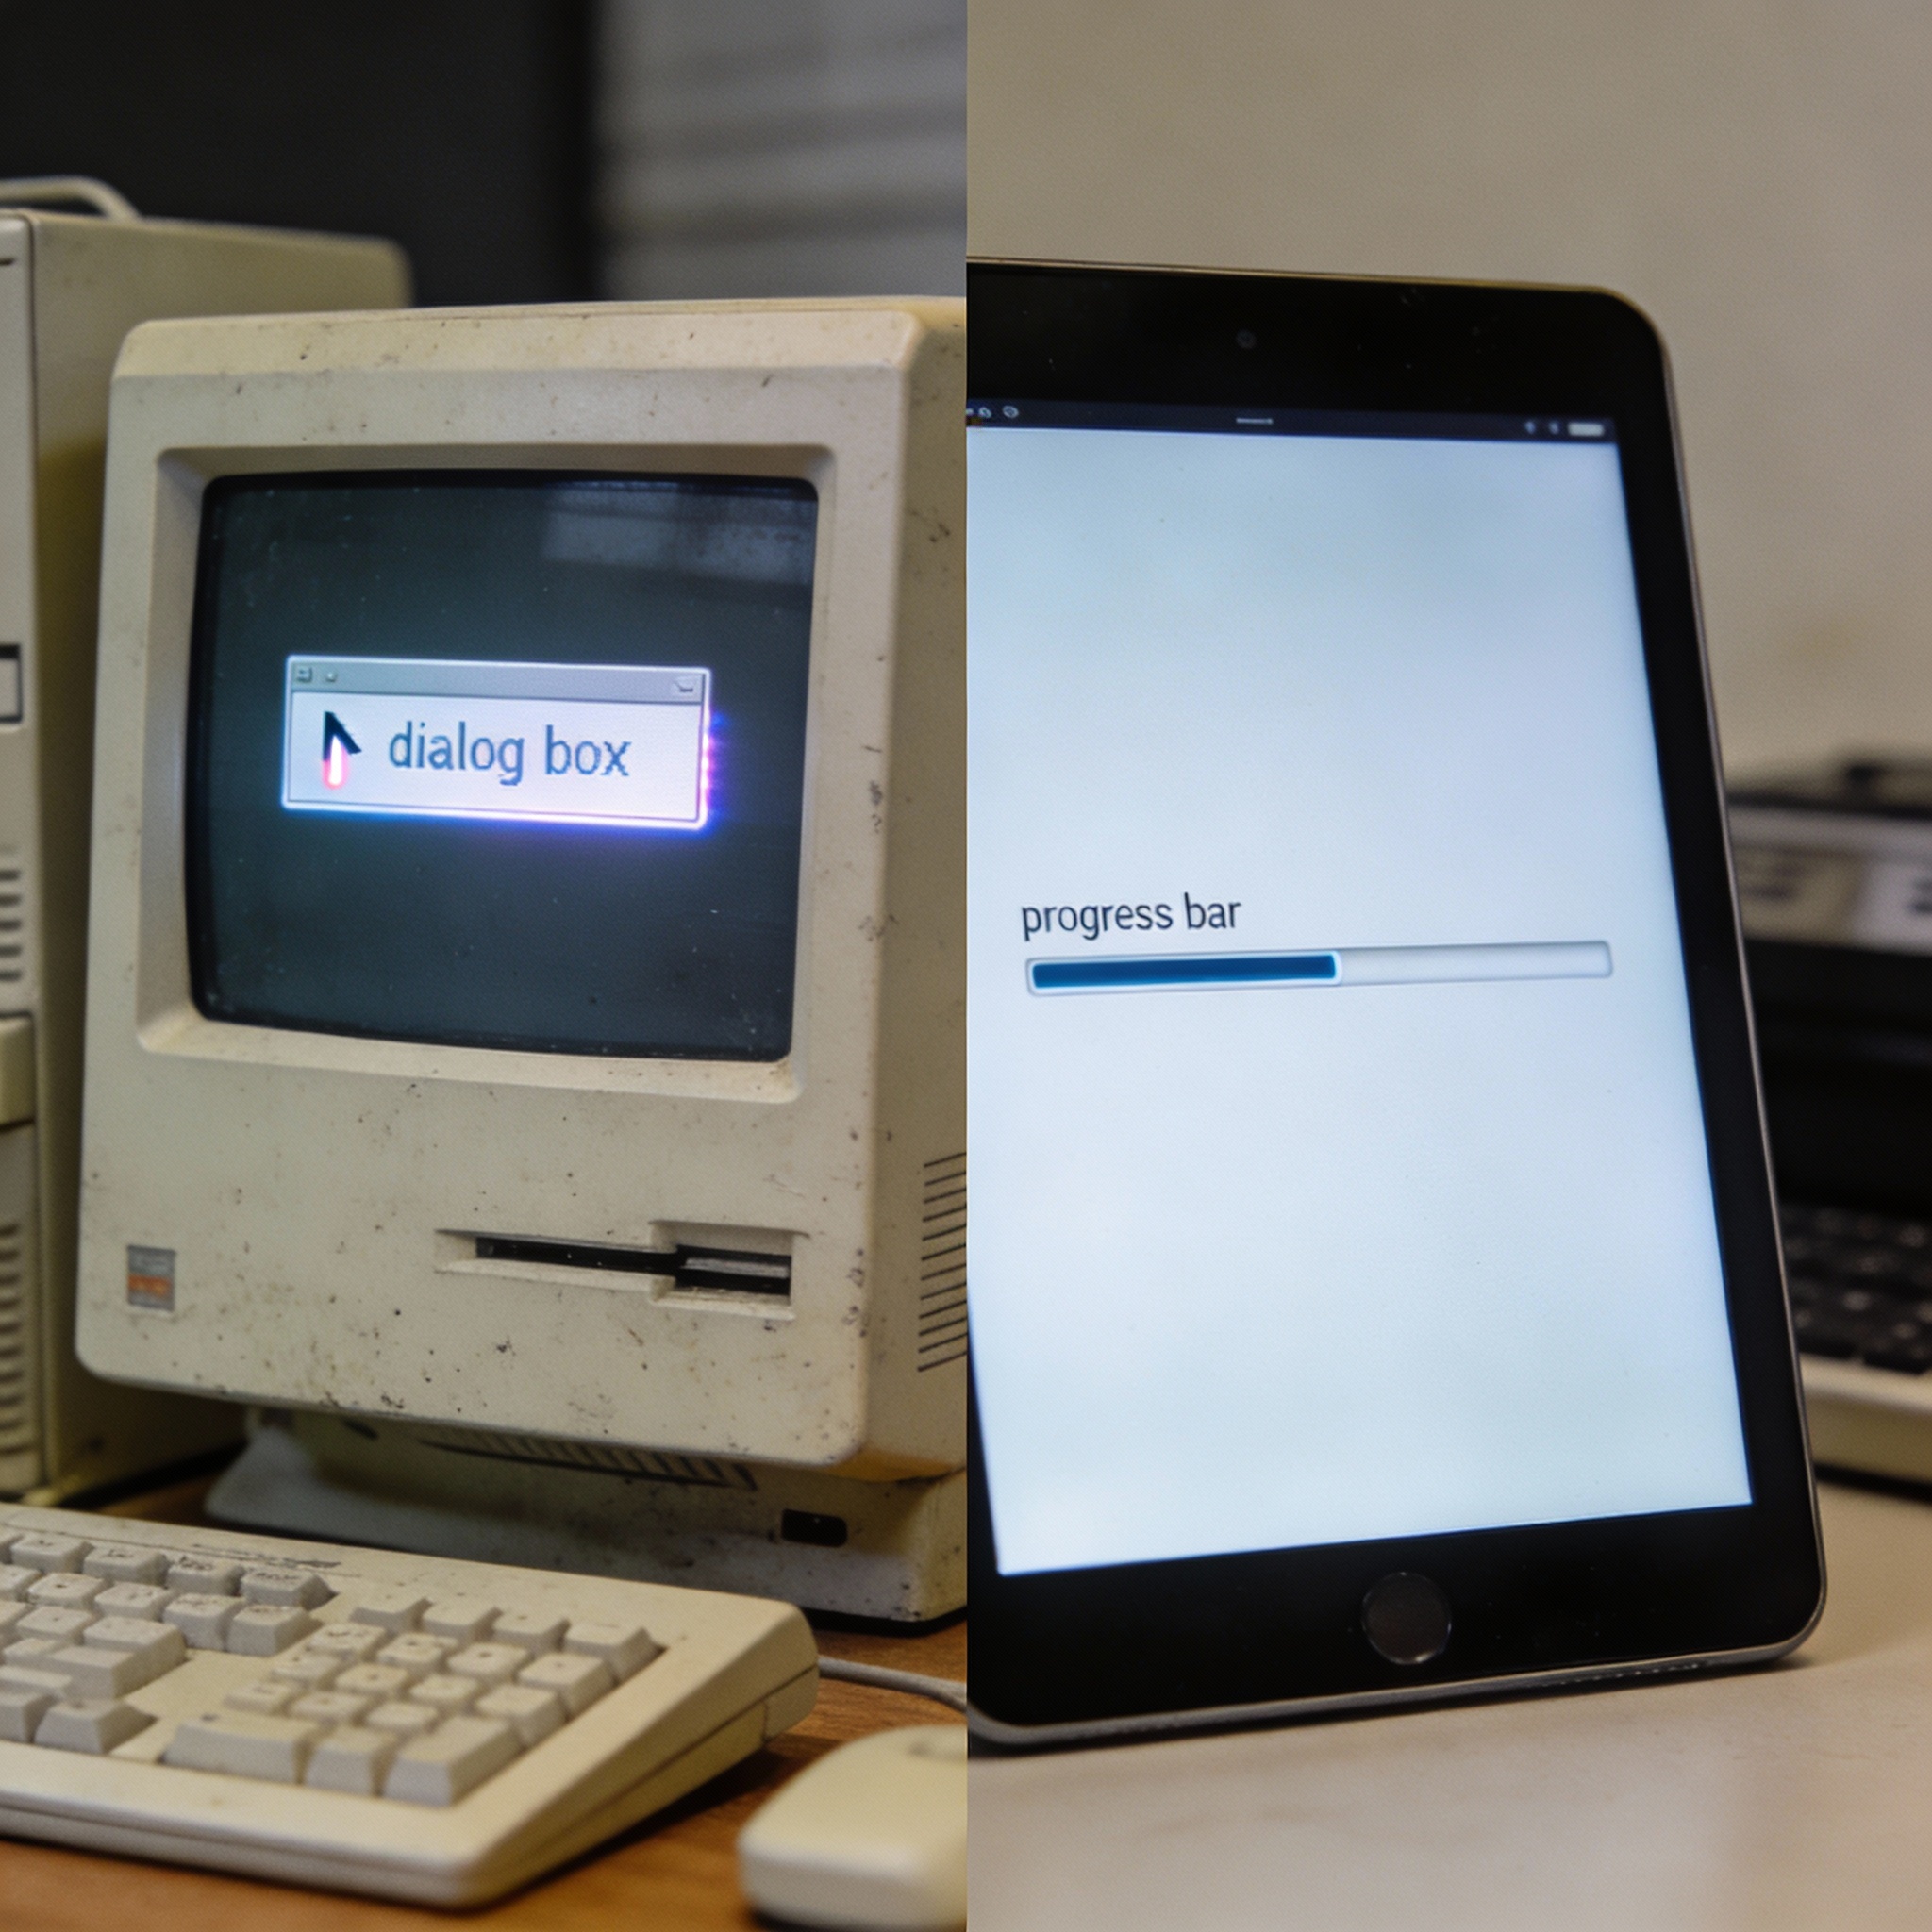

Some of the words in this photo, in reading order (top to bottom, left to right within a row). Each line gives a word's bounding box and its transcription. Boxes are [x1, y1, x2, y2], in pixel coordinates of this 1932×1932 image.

[389, 720, 525, 786] dialog
[544, 724, 631, 776] box
[1022, 904, 1174, 941] progress
[1183, 891, 1242, 930] bar
